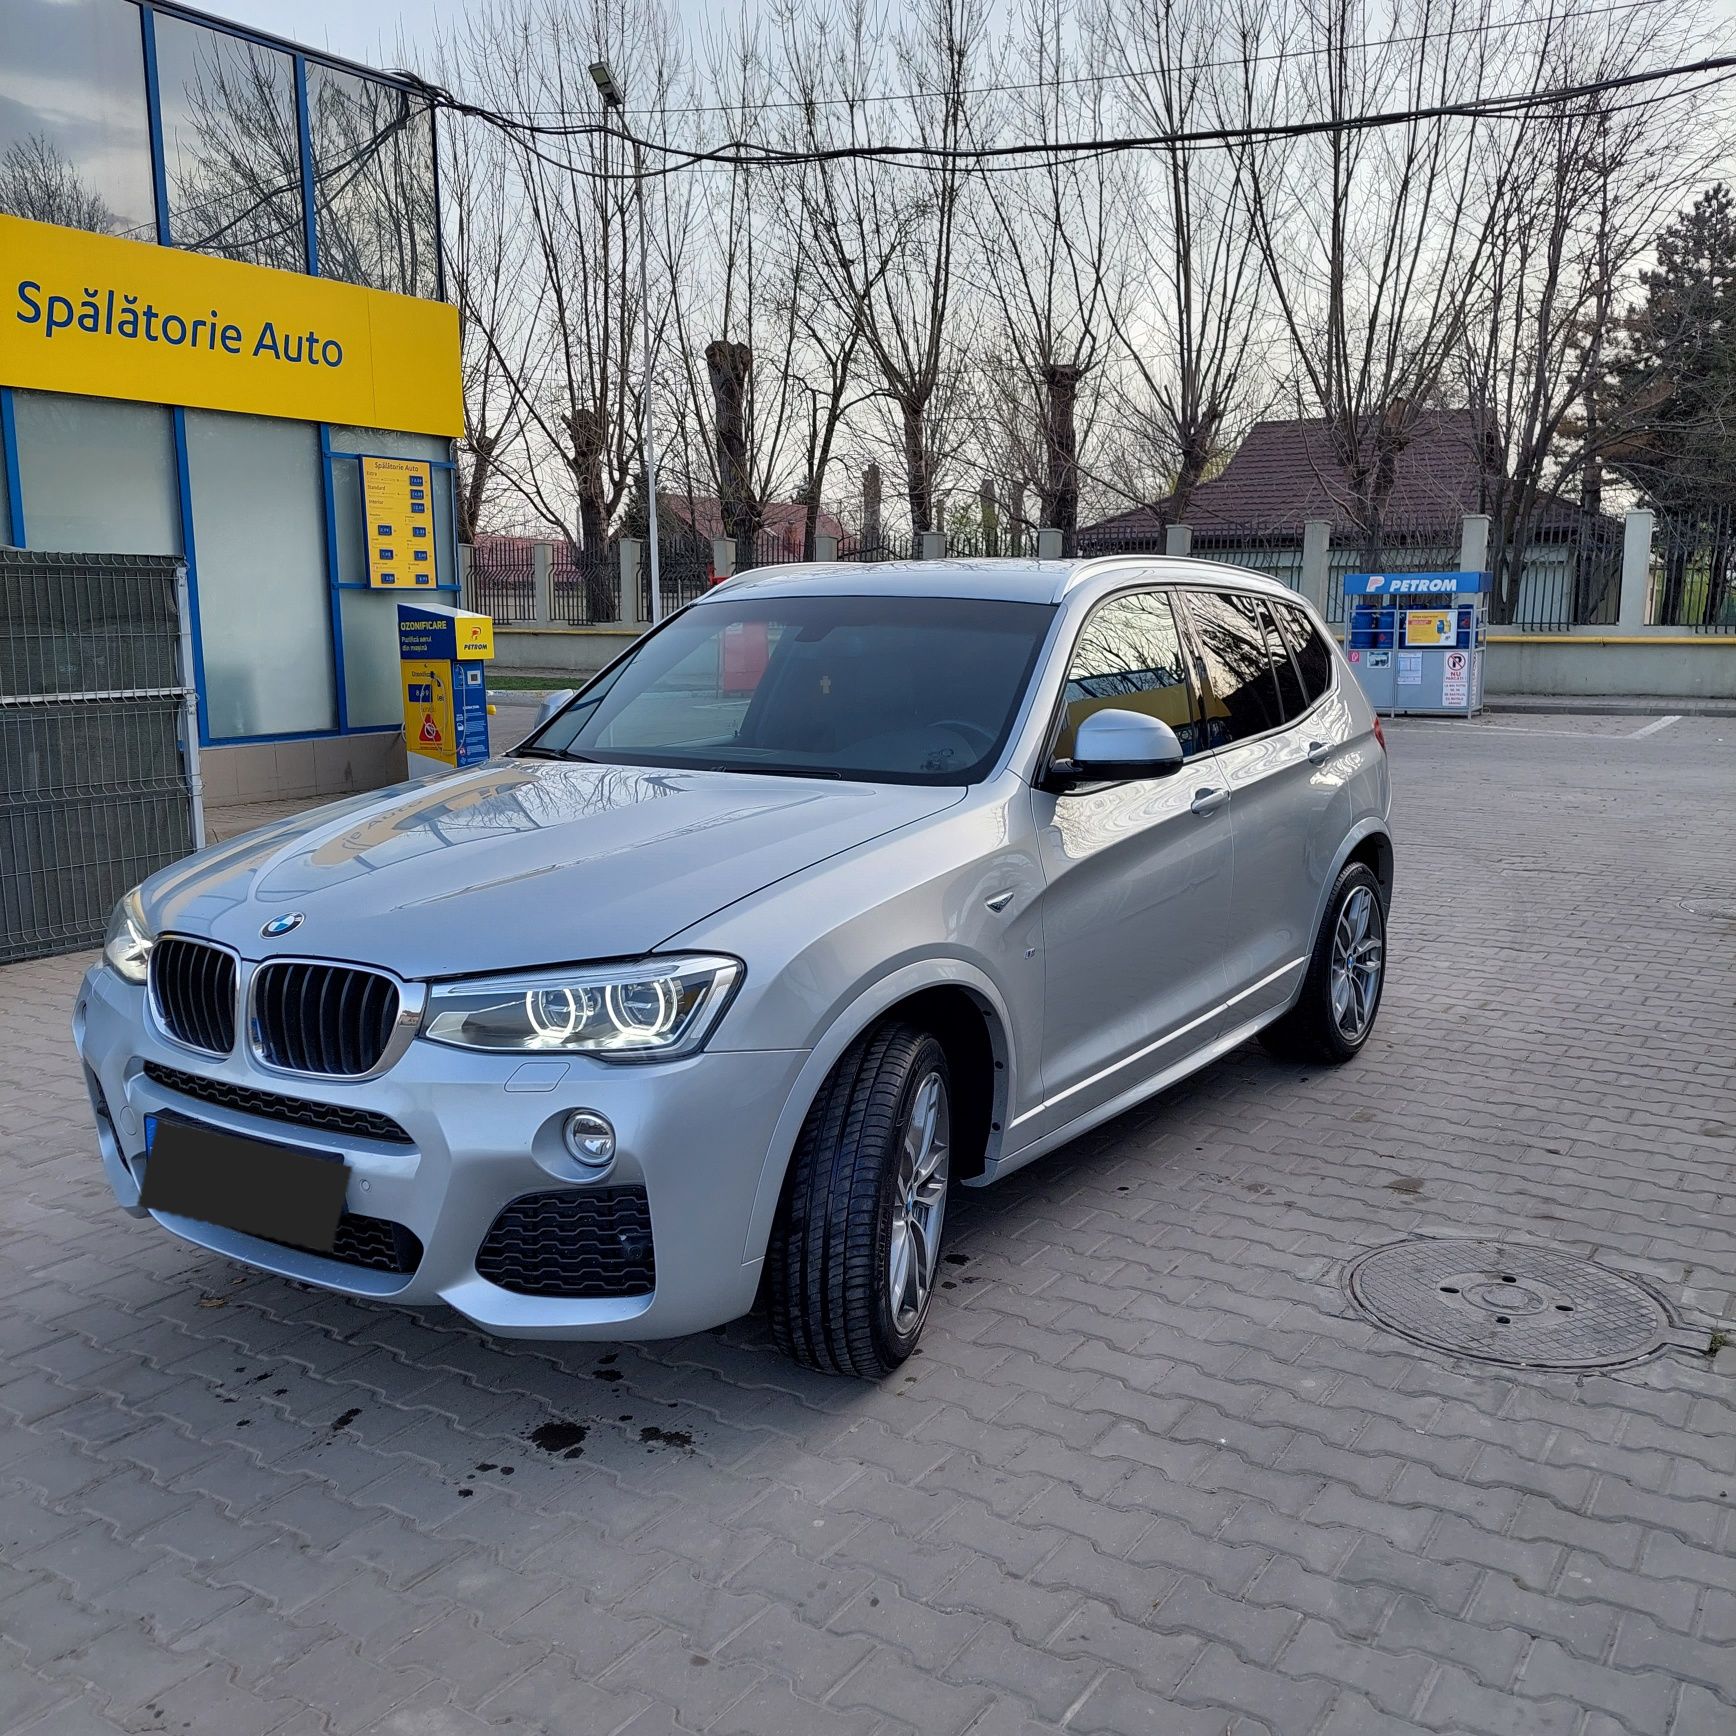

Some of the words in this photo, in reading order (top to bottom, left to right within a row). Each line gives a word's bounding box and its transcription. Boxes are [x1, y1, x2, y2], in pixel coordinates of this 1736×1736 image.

[16, 281, 242, 353] Spălătorie
[253, 322, 344, 367] Auto
[1389, 578, 1457, 592] PETROM
[400, 620, 447, 631] OZONIFICARE
[463, 643, 488, 651] PETROM
